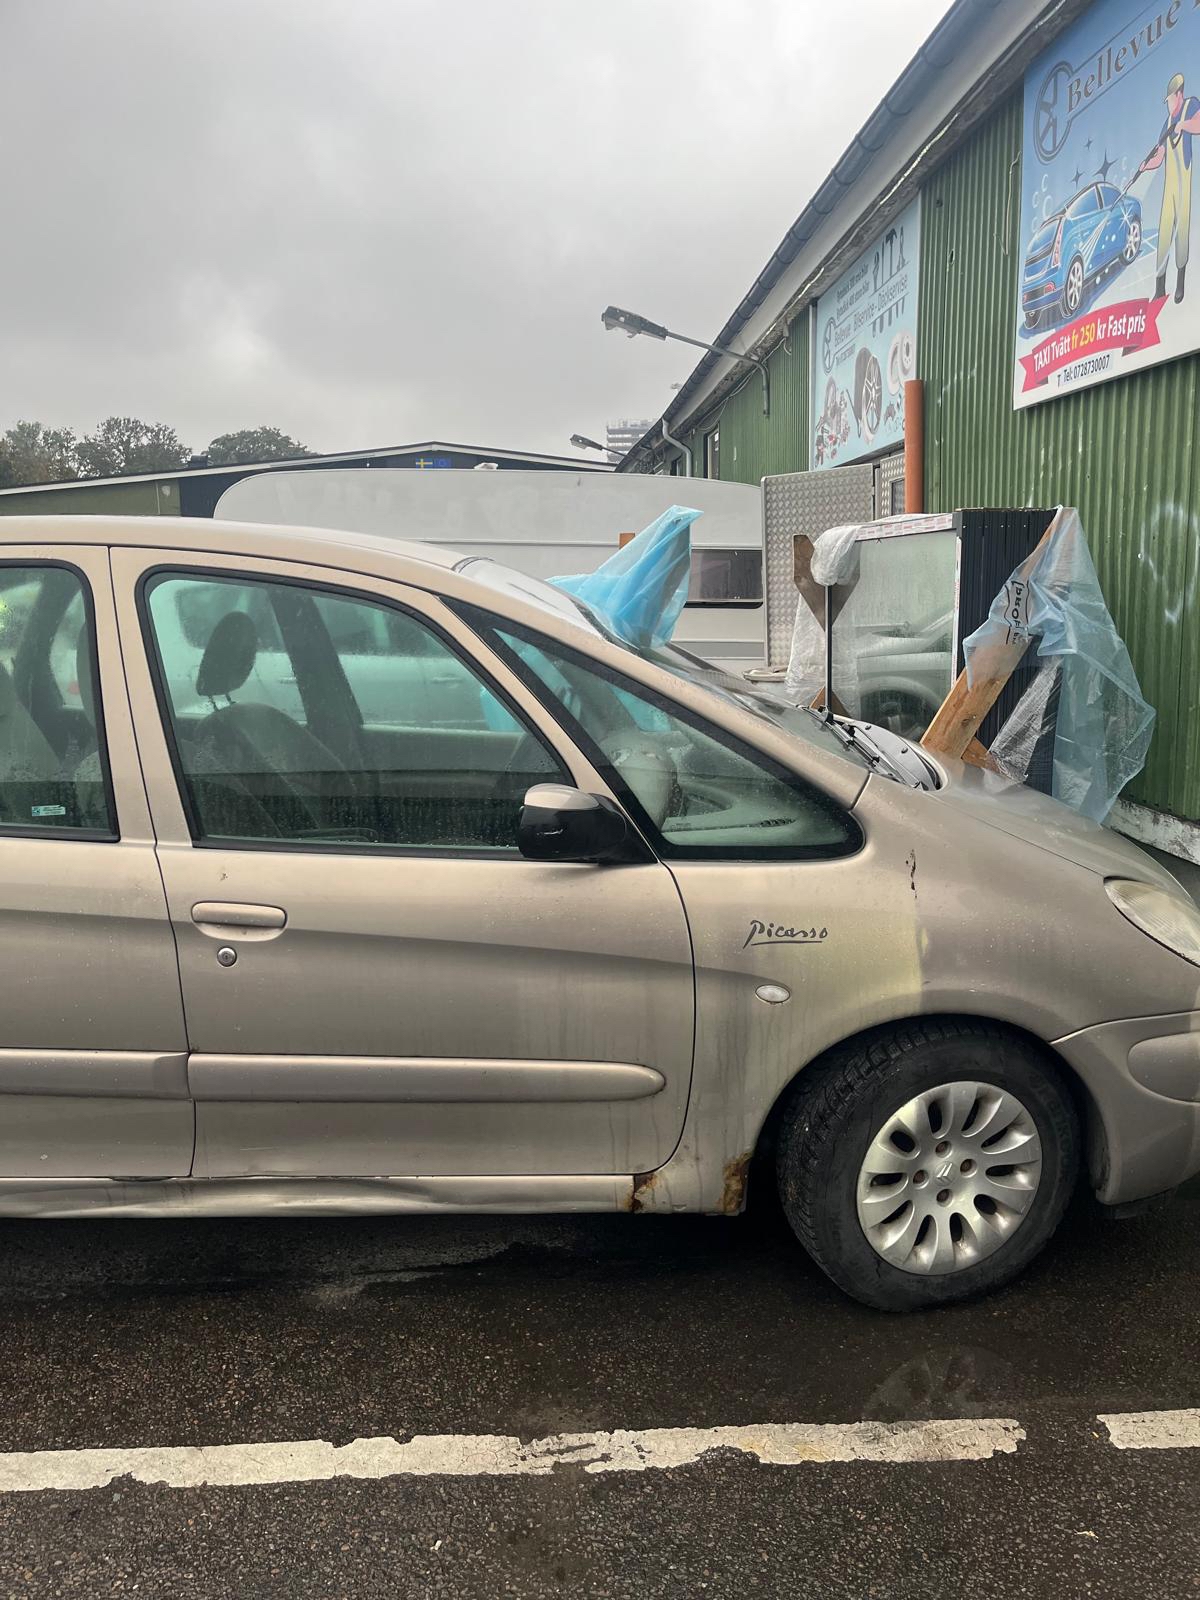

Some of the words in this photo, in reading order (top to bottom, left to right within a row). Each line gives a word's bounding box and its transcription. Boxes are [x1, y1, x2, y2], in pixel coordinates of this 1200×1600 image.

[1066, 0, 1181, 113] Bellevue
[1033, 345, 1051, 373] TAXI
[1050, 335, 1071, 361] Tvätt
[1071, 328, 1079, 351] fr
[1079, 321, 1096, 348] 250
[1096, 317, 1107, 341] kr
[1107, 313, 1127, 339] Fast
[1126, 308, 1147, 341] pris
[742, 919, 829, 950] Picasso
